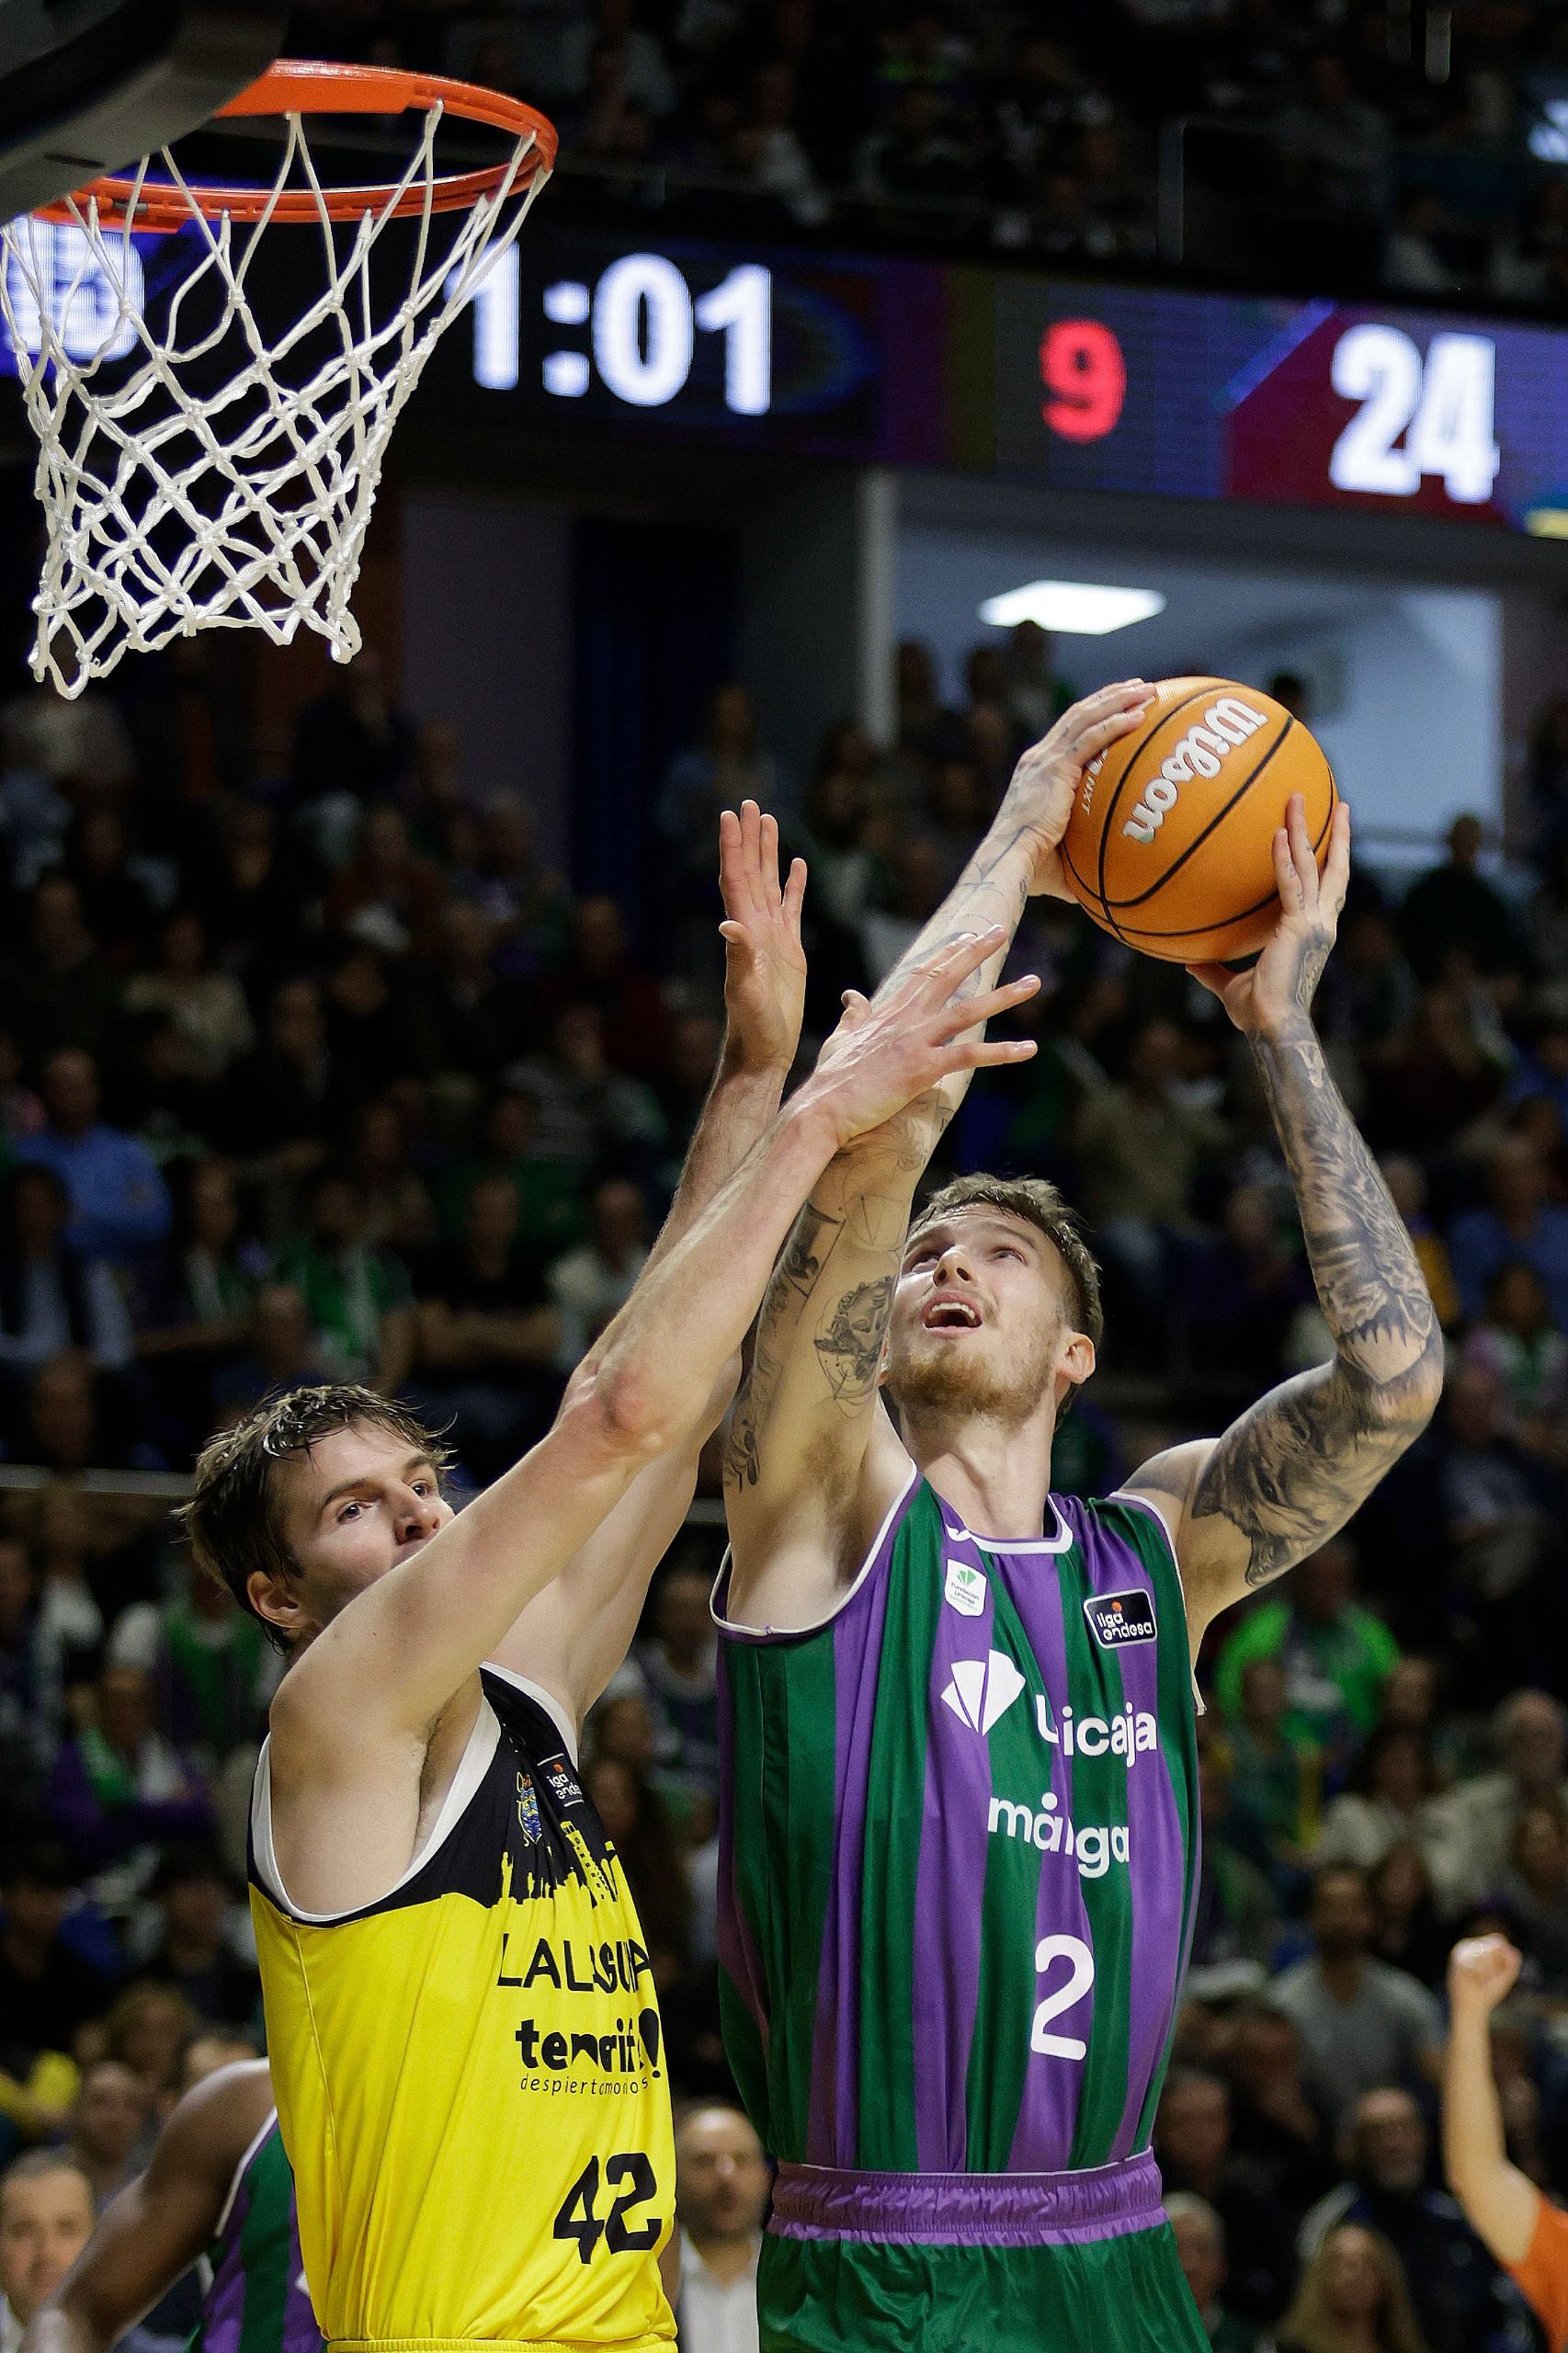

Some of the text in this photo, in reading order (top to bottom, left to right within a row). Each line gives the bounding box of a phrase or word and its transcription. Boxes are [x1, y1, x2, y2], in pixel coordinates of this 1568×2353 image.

[442, 235, 774, 416] 1:01
[1040, 318, 1127, 444] 9
[1329, 324, 1500, 504] 24
[1121, 698, 1268, 844] Wilson
[546, 1774, 570, 1789] iga
[1031, 1935, 1095, 2061] 2
[553, 2153, 662, 2265] 42
